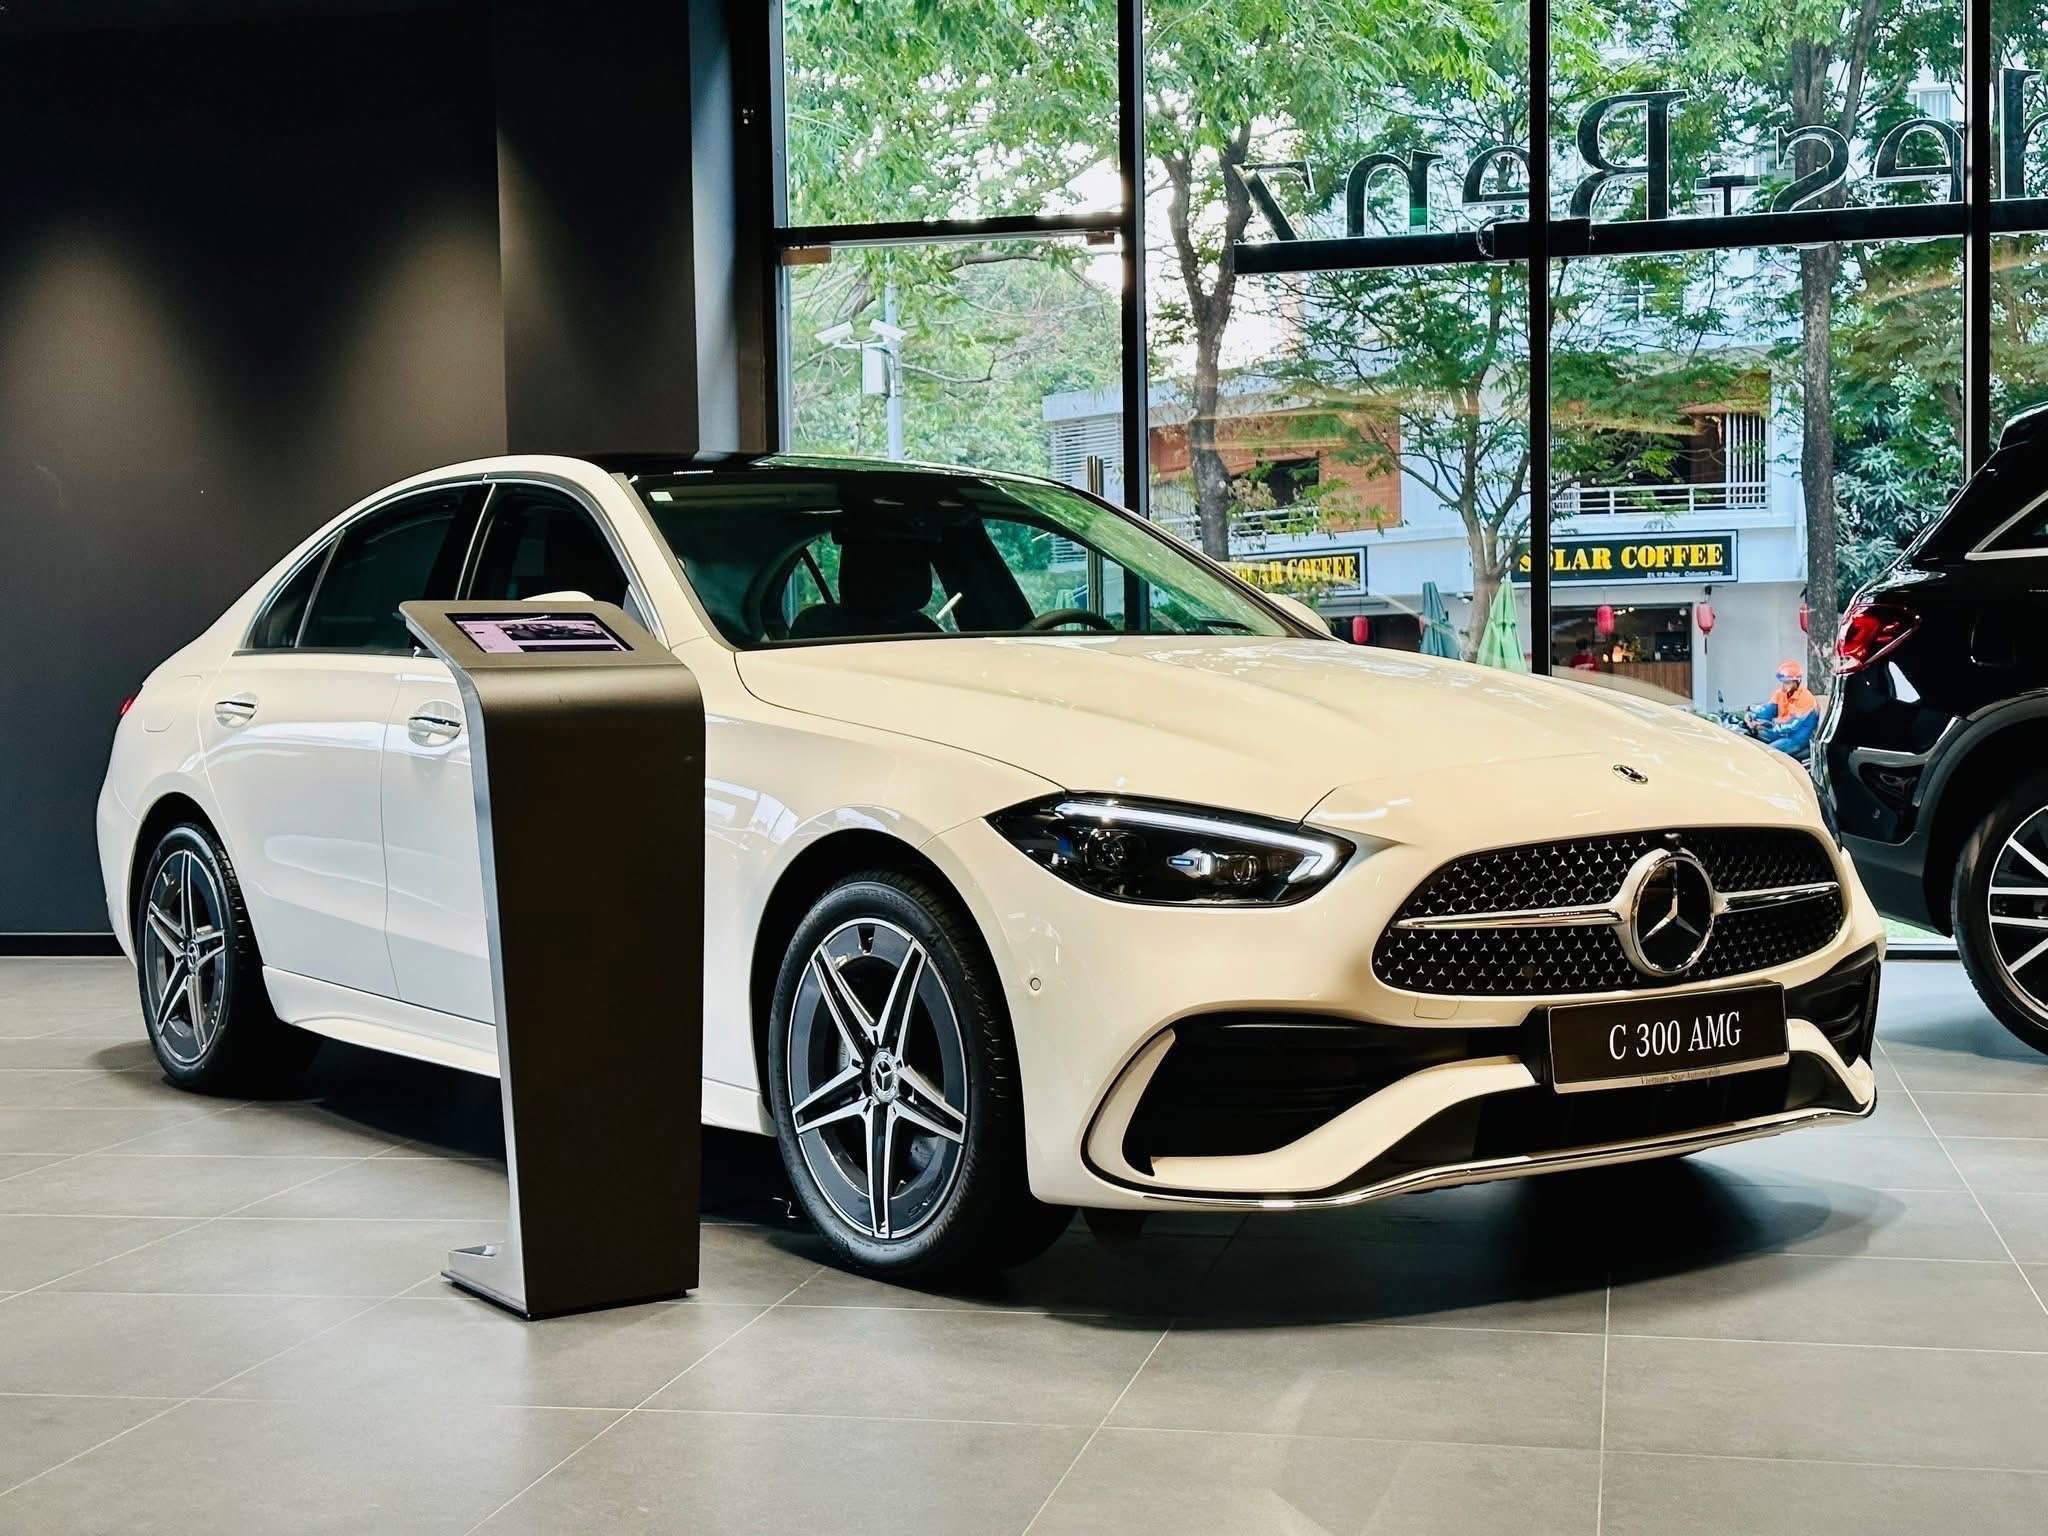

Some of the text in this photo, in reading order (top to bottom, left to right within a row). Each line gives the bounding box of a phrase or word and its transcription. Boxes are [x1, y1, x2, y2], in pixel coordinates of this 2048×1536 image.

[1620, 543, 1723, 569] COFFEE
[1609, 1011, 1742, 1060] C 300 AMG
